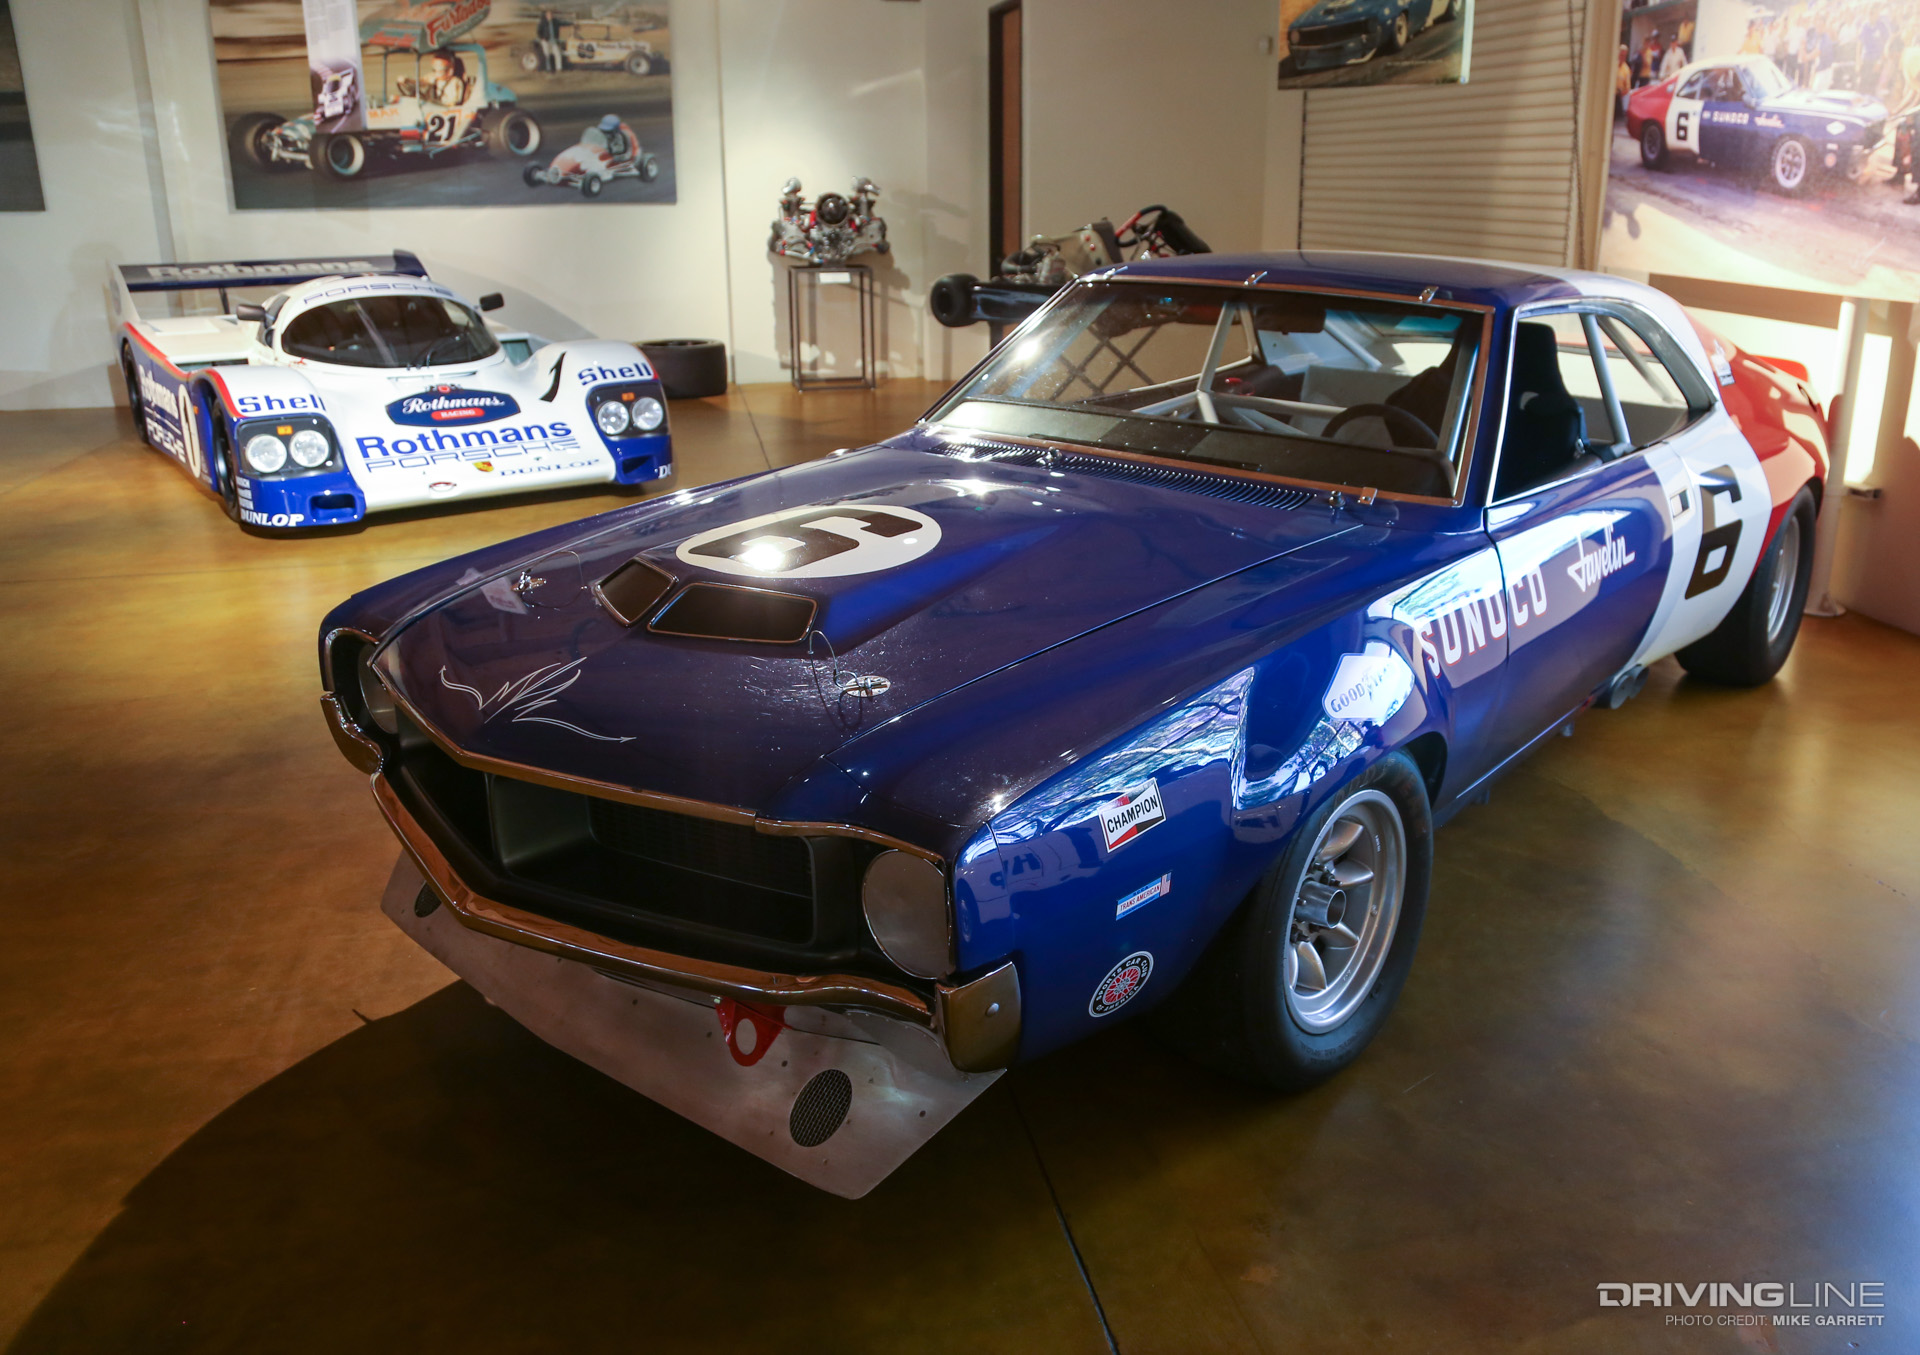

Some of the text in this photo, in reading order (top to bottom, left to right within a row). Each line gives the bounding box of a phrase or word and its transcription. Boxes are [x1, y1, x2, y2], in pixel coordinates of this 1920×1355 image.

[428, 114, 456, 142] 21
[1677, 112, 1690, 141] 6
[146, 261, 373, 282] Rothmans
[304, 283, 454, 304] PORSCHE
[539, 351, 567, 403] 1
[578, 362, 653, 386] Shell
[238, 394, 326, 413] Shell
[440, 409, 476, 418] RACING
[355, 421, 572, 459] Rothmans
[365, 437, 581, 473] PORSCHE
[500, 458, 600, 477] DUNLOP
[240, 509, 305, 527] DUNLOP
[1685, 464, 1743, 600] 6
[1566, 510, 1636, 592] Javelin
[1414, 562, 1547, 679] SUNOCO
[1106, 794, 1158, 834] CHAMPION
[1120, 897, 1136, 912] TRANS
[1135, 884, 1160, 903] AMERICAN
[1096, 957, 1149, 1001] SPORTS CAR CLUB
[1103, 985, 1140, 1012] AMERICA
